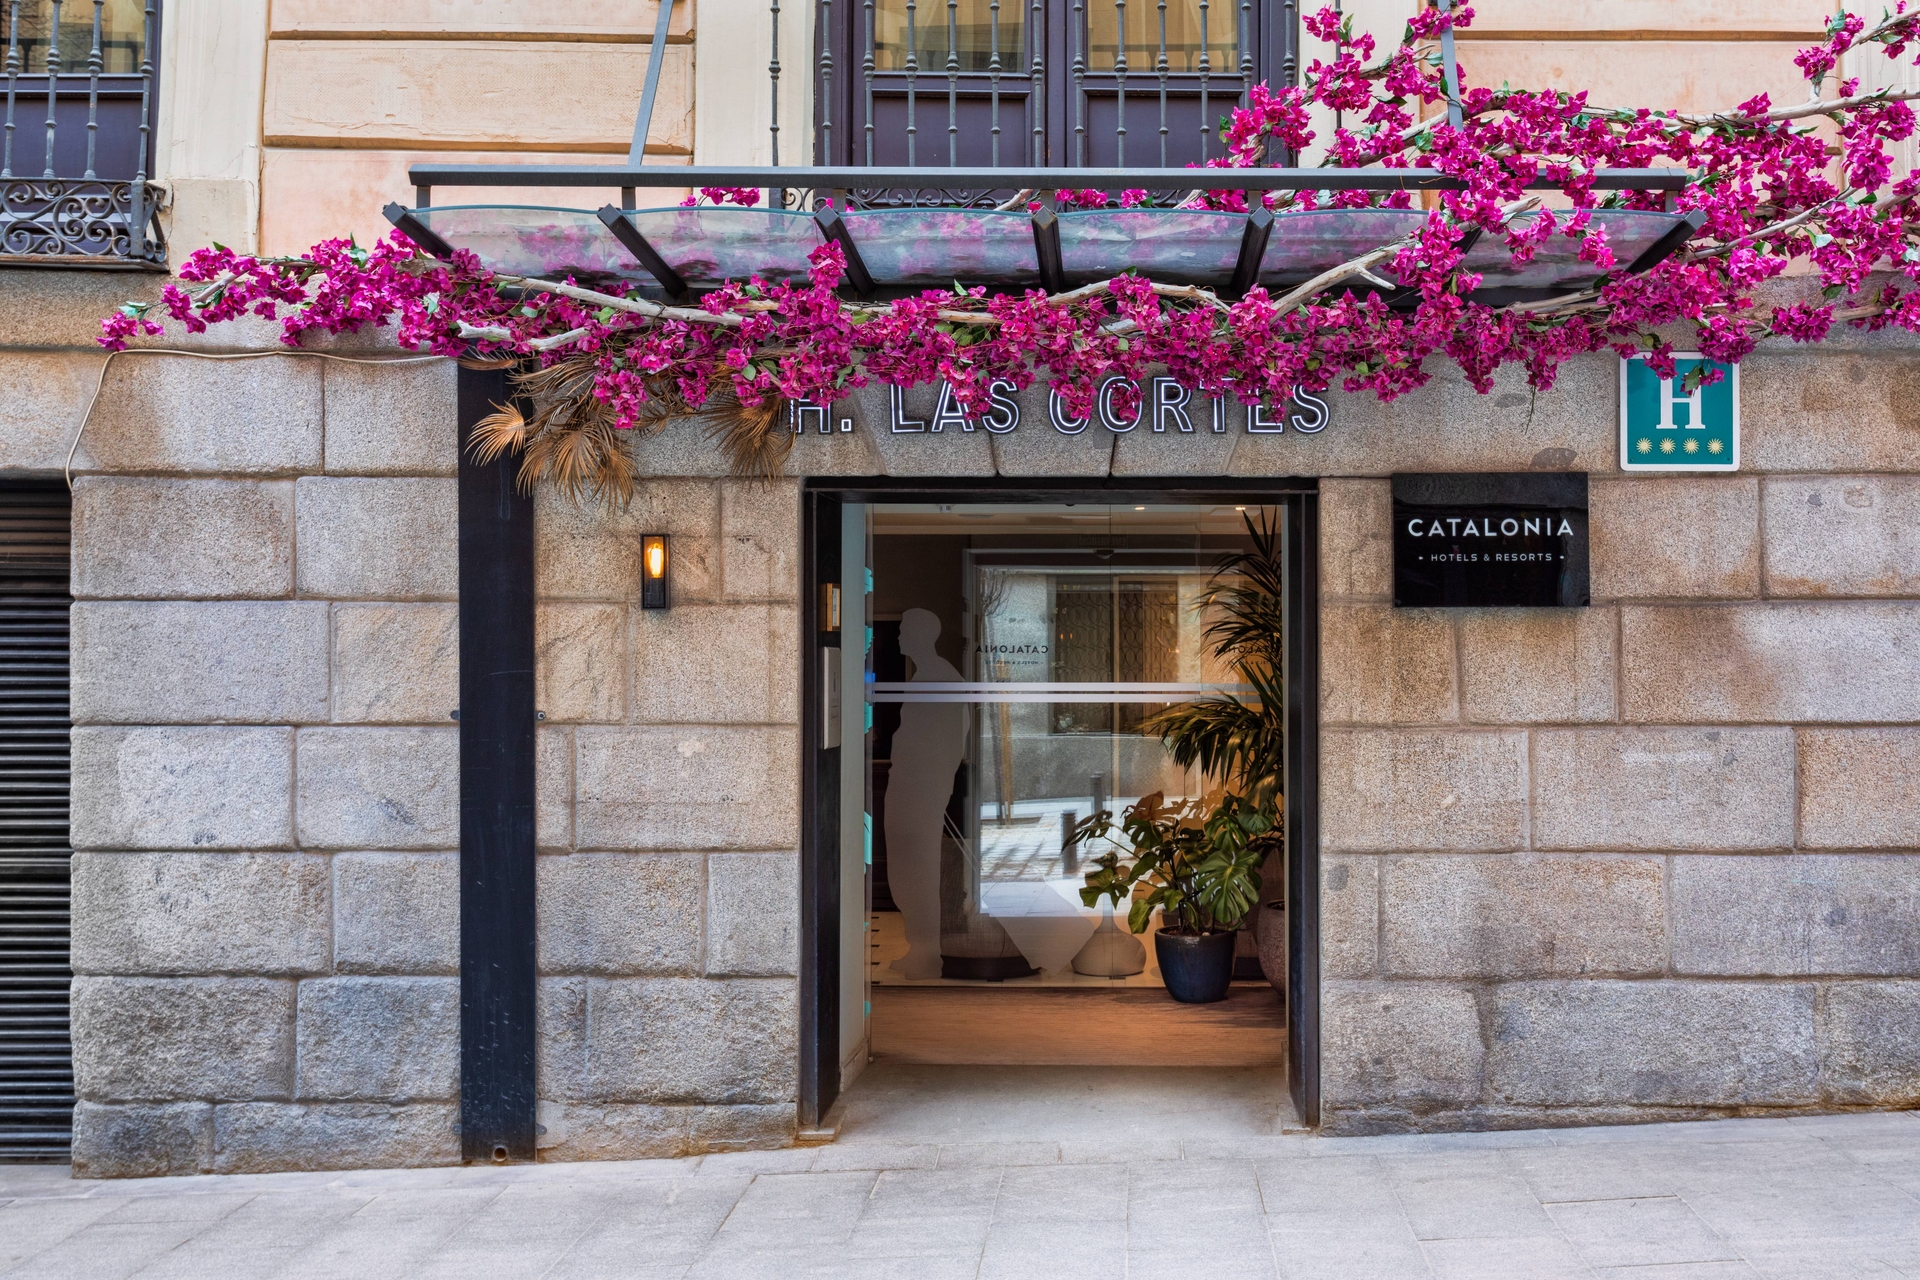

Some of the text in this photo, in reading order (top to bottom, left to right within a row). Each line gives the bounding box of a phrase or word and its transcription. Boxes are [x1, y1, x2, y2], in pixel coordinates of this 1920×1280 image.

[889, 376, 1021, 434] LAS
[1656, 372, 1706, 429] H
[1408, 518, 1574, 537] CATALONIA
[1431, 553, 1552, 562] HOTELS & RESORTS
